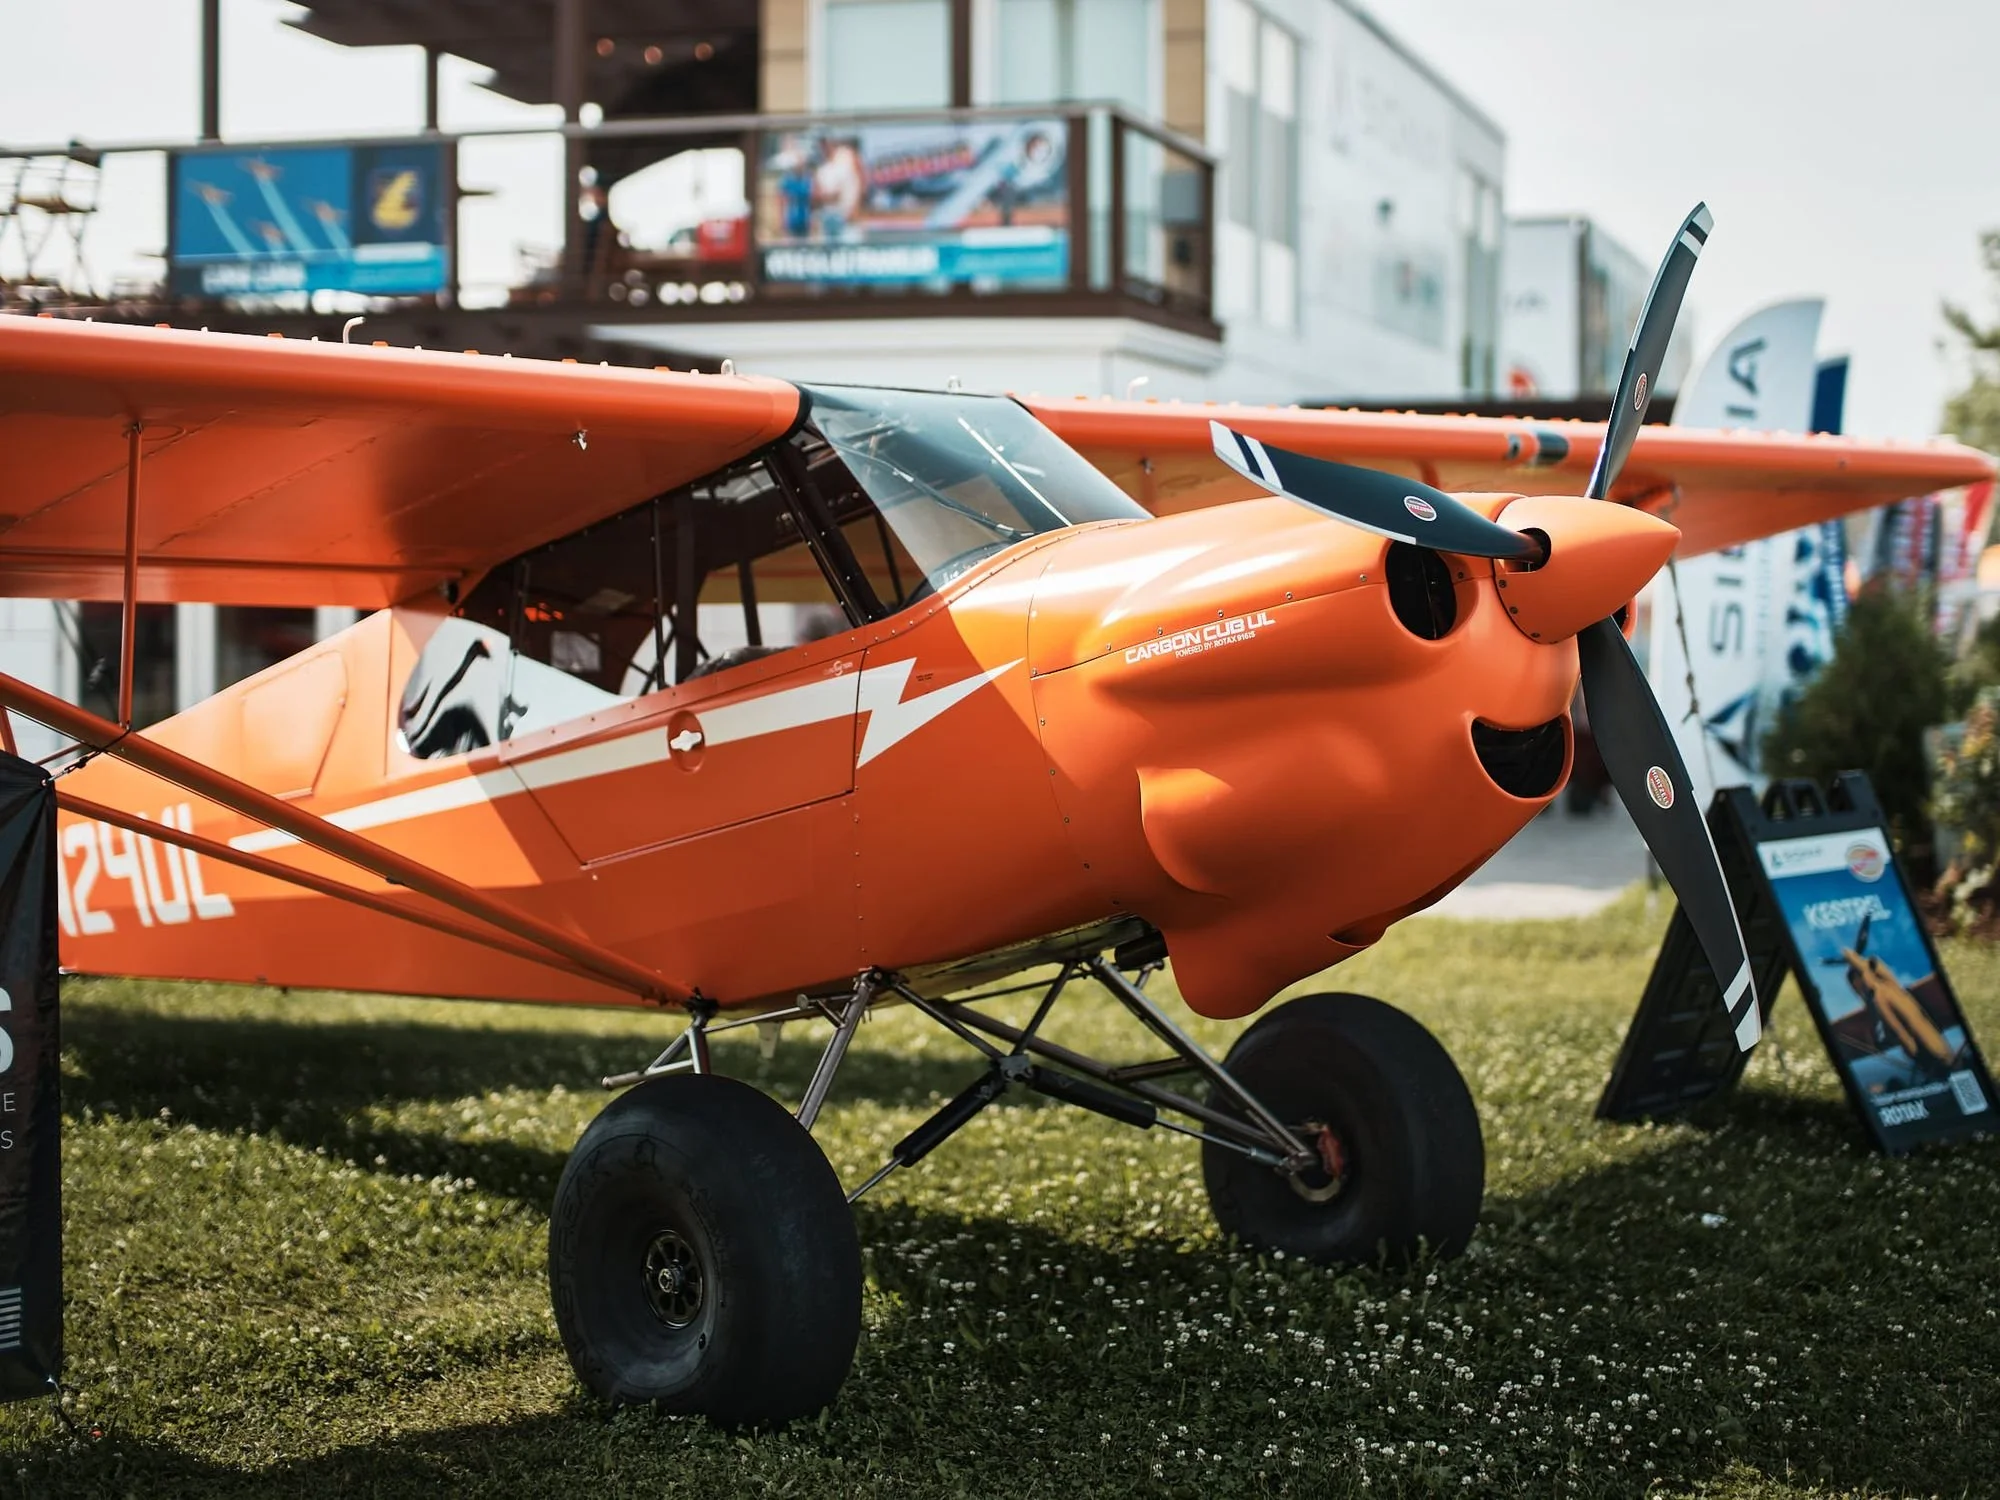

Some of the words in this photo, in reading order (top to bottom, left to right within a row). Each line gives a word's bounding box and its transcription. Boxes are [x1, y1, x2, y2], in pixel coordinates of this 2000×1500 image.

[1124, 631, 1201, 665] CARBON
[1203, 619, 1245, 640] CUB
[1247, 611, 1277, 630] UL
[1175, 644, 1203, 659] POWERED
[1213, 636, 1237, 648] ROTAX
[1651, 769, 1669, 806] HARTZELL
